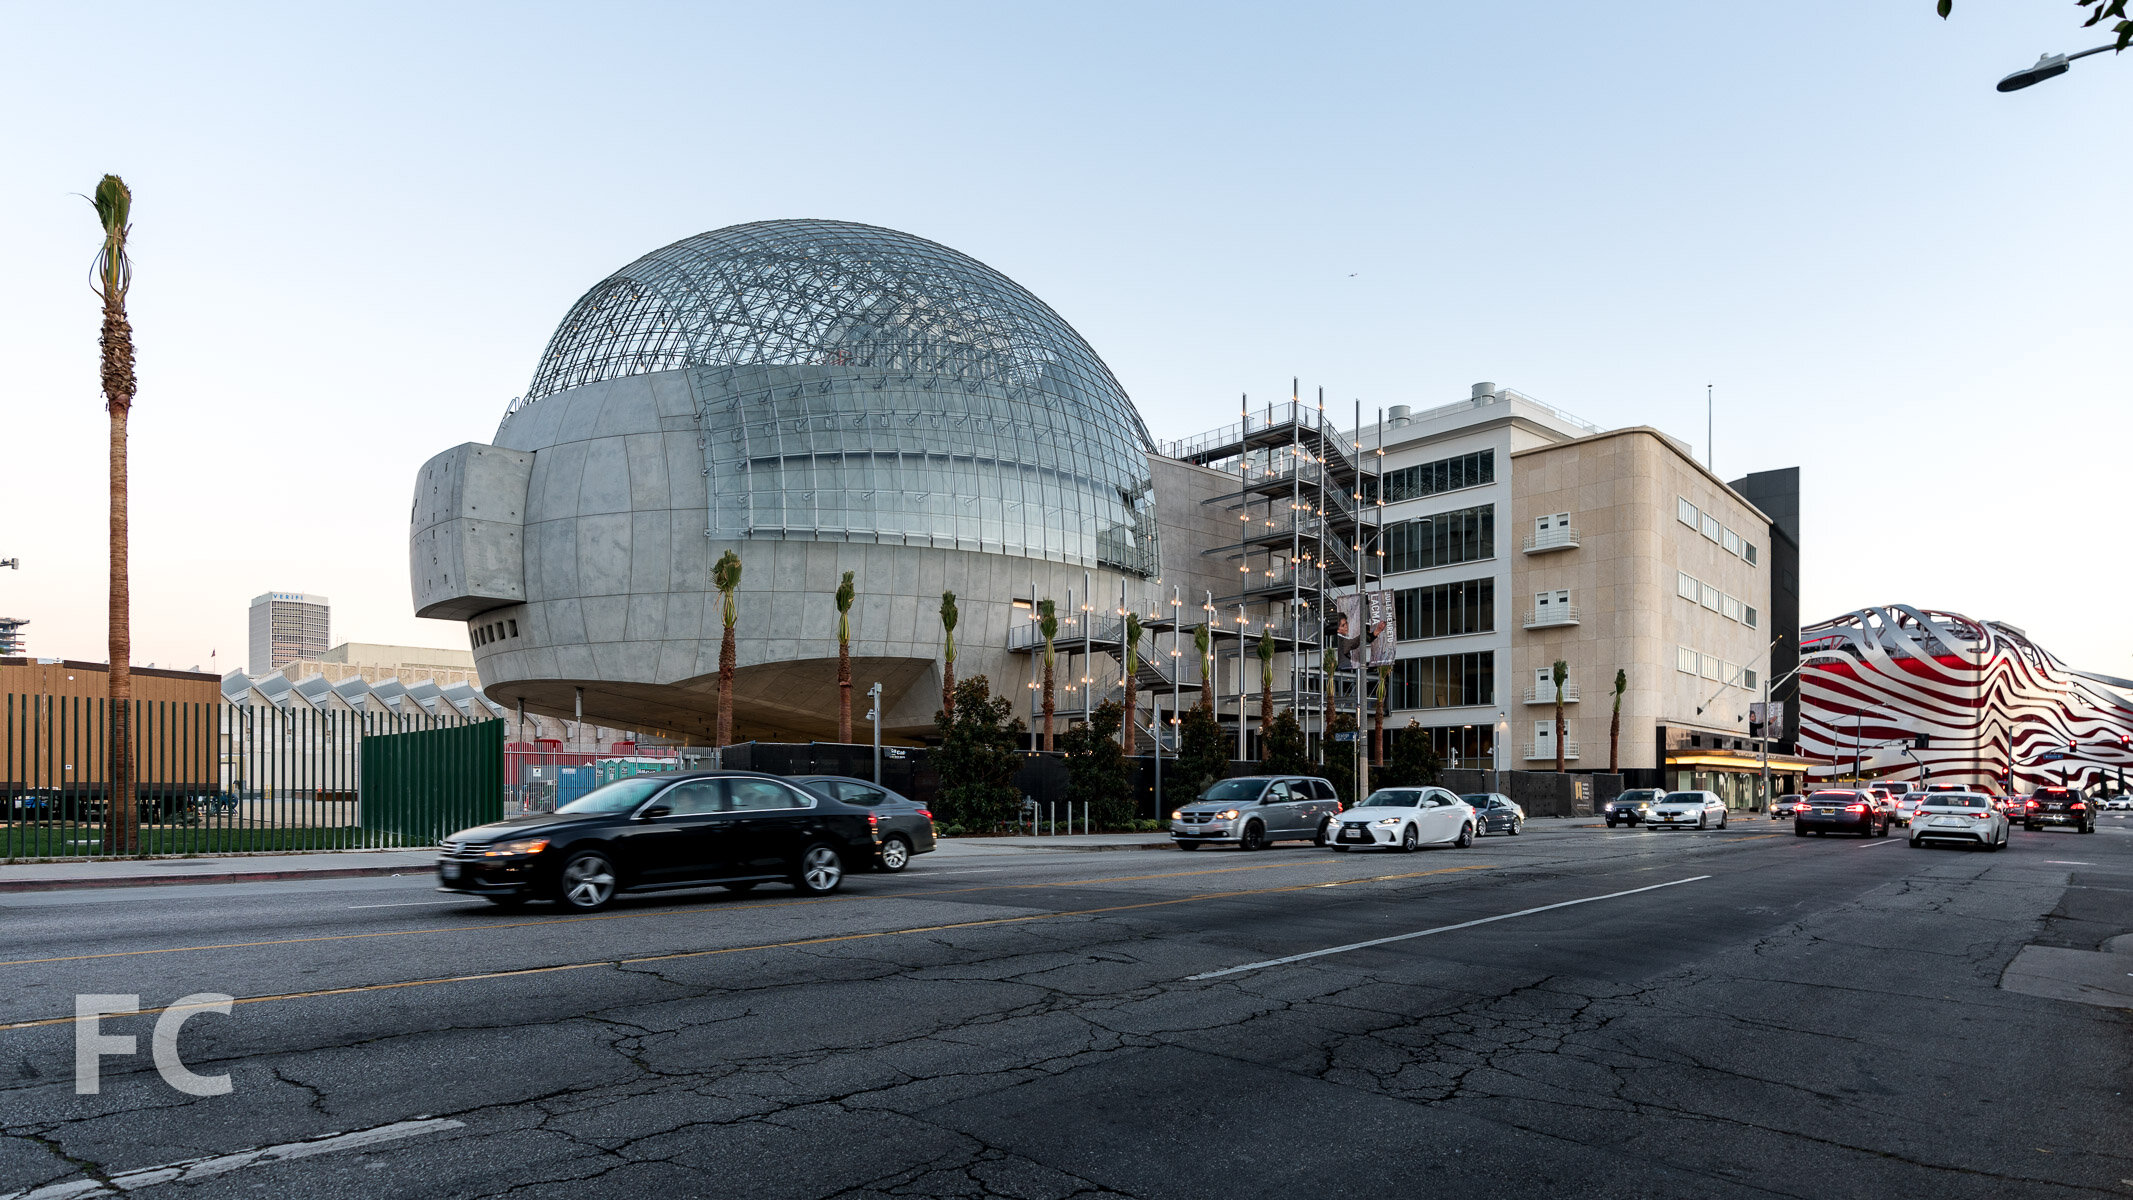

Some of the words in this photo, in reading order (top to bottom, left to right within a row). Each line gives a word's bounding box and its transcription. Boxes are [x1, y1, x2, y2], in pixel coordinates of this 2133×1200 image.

[1370, 593, 1380, 625] LACMA
[1384, 592, 1392, 611] JULIE
[1386, 612, 1394, 643] MEHRETU
